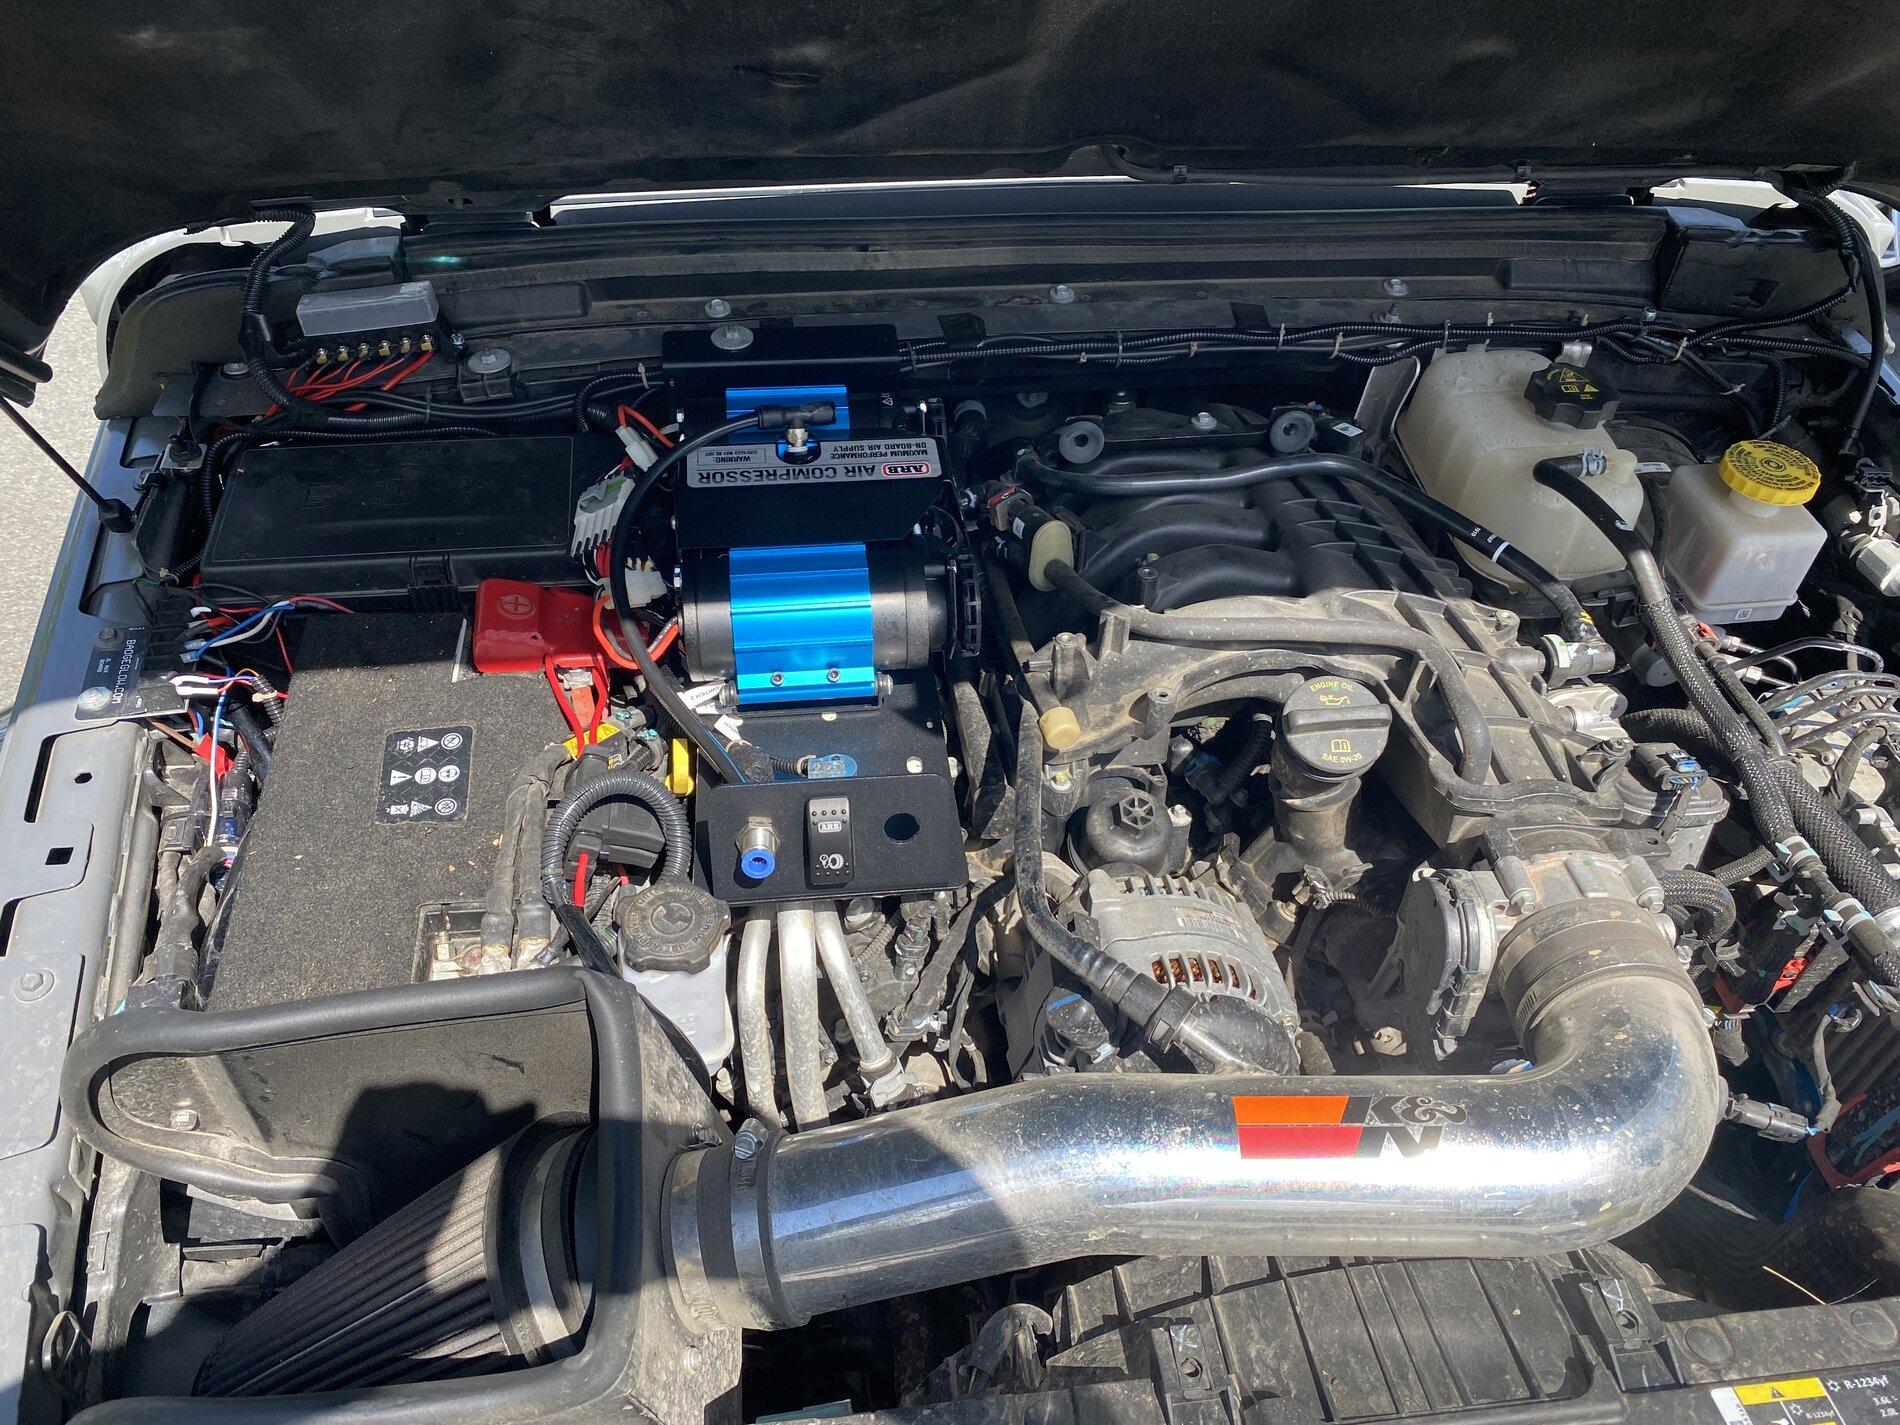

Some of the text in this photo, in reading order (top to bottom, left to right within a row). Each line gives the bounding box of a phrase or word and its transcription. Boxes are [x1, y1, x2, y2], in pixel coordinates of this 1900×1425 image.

[832, 441, 927, 453] ON-BOARD AIR SUPPLY
[830, 449, 928, 460] MAXIMUM PERFORMANCE
[698, 464, 924, 485] ARB AIR COMPRESSOR
[112, 639, 137, 704] BADGEGLOW.COM
[1310, 681, 1355, 692] ENGINE OIL
[1322, 752, 1339, 763] SAE
[1843, 1374, 1890, 1391] R-1234yf
